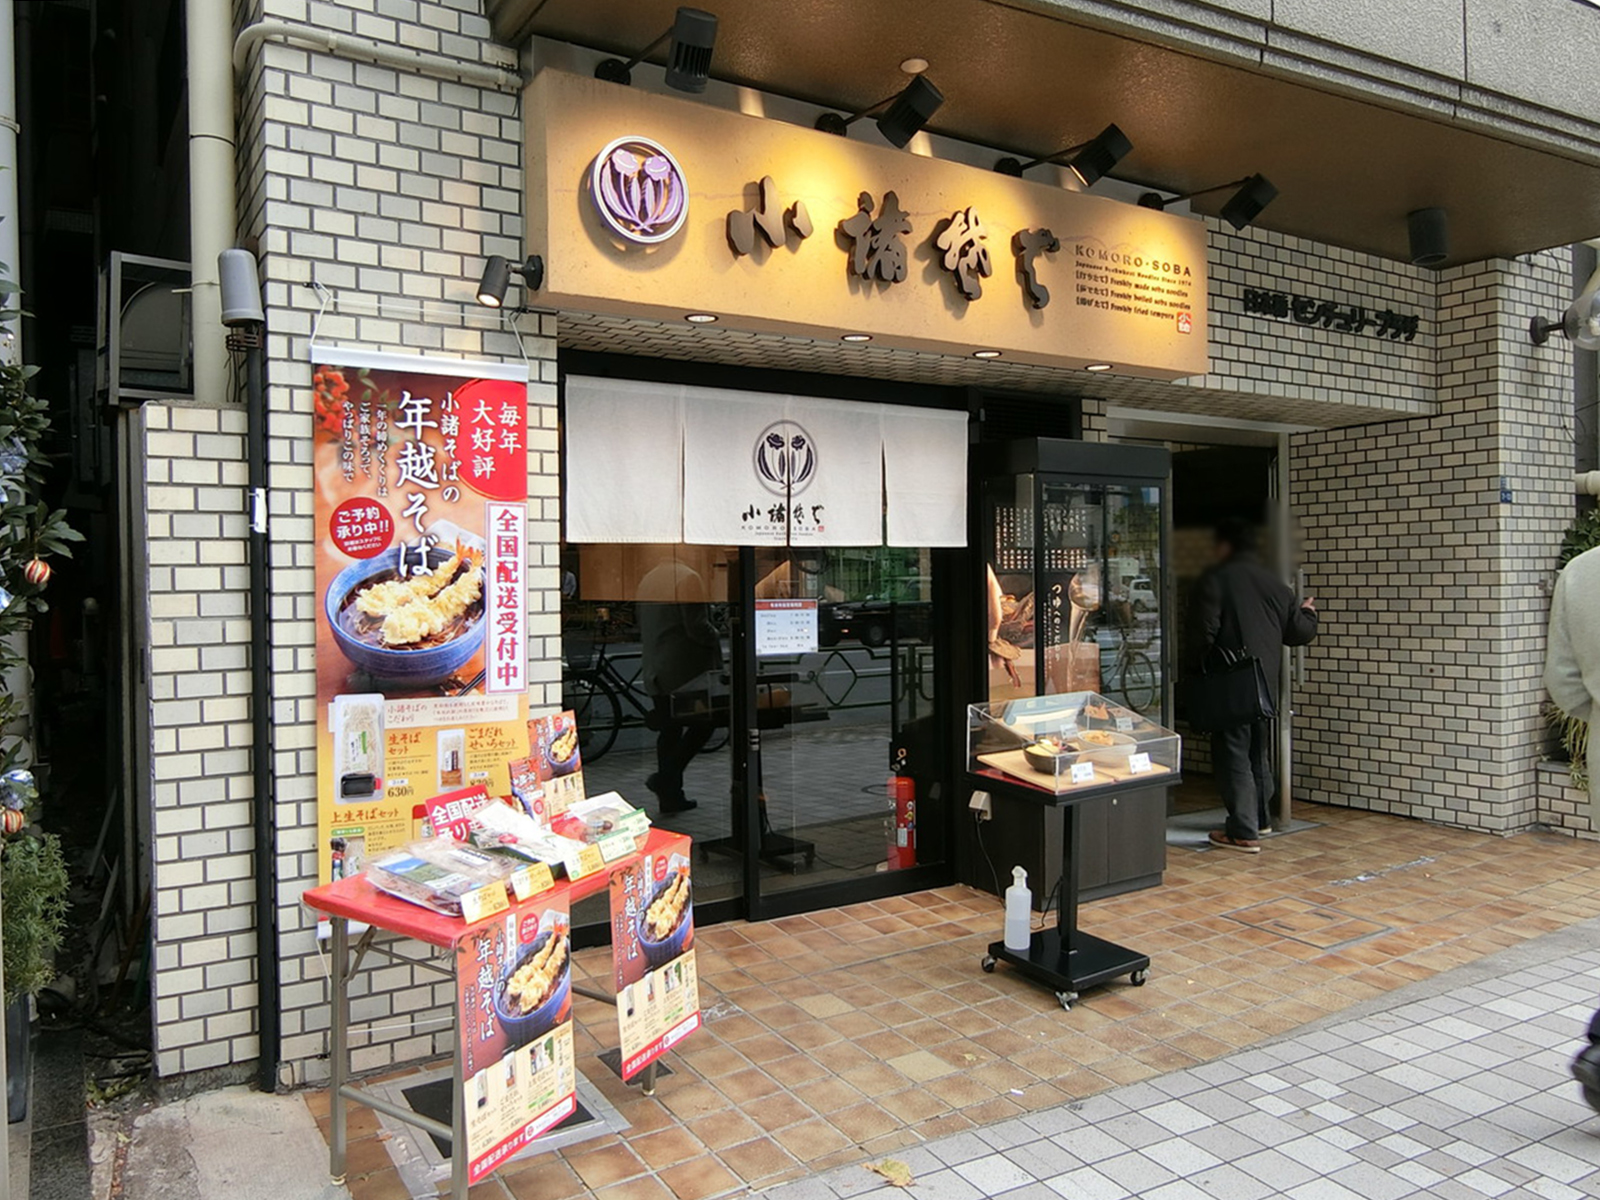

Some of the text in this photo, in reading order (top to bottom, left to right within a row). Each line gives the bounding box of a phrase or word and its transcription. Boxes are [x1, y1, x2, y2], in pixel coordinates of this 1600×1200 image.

[1110, 277, 1132, 289] Freshly
[1134, 282, 1150, 291] made
[1152, 285, 1165, 294] soba
[1166, 288, 1188, 298] noodles
[1110, 290, 1132, 302] Freshly
[1134, 294, 1152, 303] boiled
[1154, 297, 1167, 307] soba
[1169, 300, 1191, 310] noodles
[1110, 303, 1132, 314] Freshly
[1133, 306, 1149, 316] fried
[1150, 309, 1175, 321] tempura
[498, 401, 522, 455] 毎年
[440, 391, 461, 503] 小諸そばの
[470, 399, 497, 480] 大好評
[395, 390, 441, 578] 年越そば
[338, 506, 380, 523] ご予約
[496, 508, 519, 687] 全国配送受付中
[387, 702, 428, 715] 小諸そばの
[387, 713, 415, 724] こだわり
[388, 730, 422, 746] 生そば
[468, 726, 504, 739] ごまだれ
[388, 745, 409, 755] セット
[469, 738, 516, 750] せいろセット
[331, 807, 400, 823] 上生そばセット
[624, 876, 639, 961] 年越そば
[476, 938, 496, 1041] 年越そば
[472, 1132, 525, 1177] 全国配送承ります
